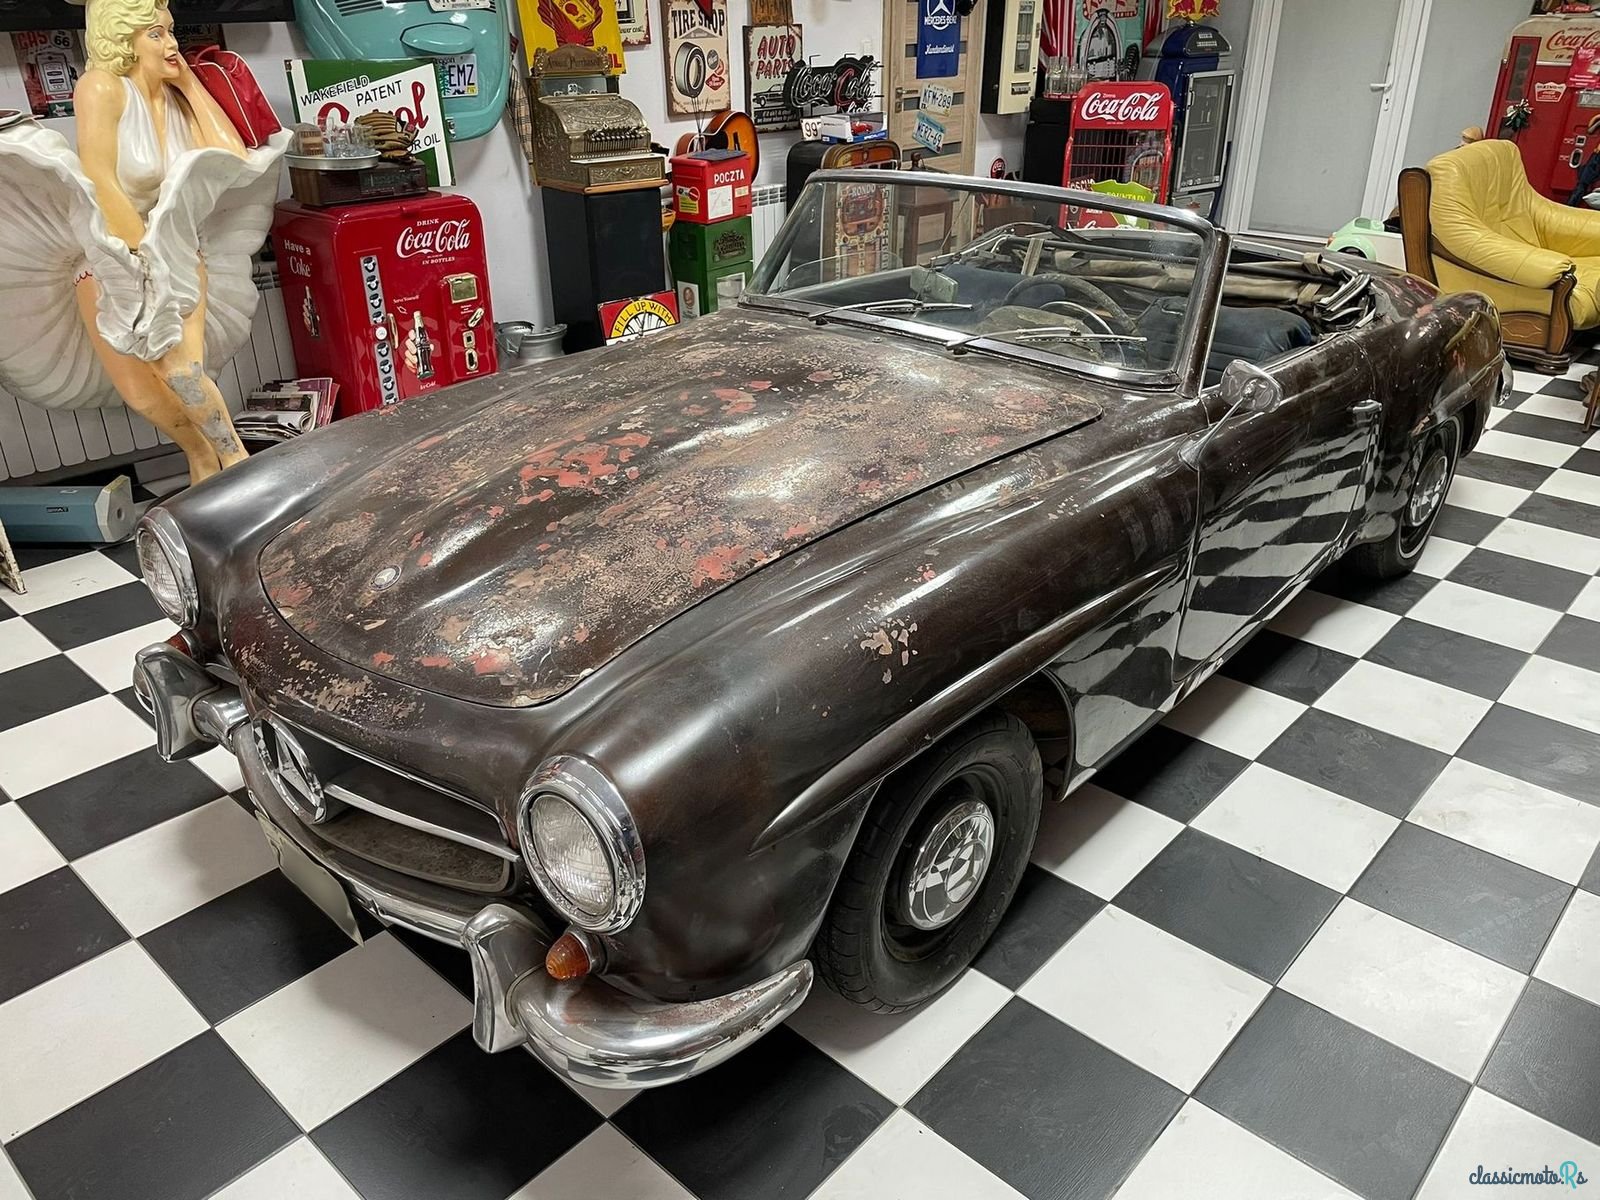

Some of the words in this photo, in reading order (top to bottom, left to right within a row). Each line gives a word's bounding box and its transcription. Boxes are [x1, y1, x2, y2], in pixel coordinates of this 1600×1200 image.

[671, 10, 696, 39] TIRE
[54, 35, 70, 47] 66
[757, 35, 796, 60] AUTO
[756, 59, 795, 80] PARTS
[301, 76, 369, 107] WAKEFIELD
[356, 80, 402, 107] PATENT
[1081, 92, 1165, 121] Coca-Cola
[424, 133, 440, 147] OIL
[714, 168, 745, 185] POCZTA
[417, 218, 440, 227] DRINK
[284, 240, 304, 253] Have
[305, 247, 311, 255] a
[396, 219, 471, 258] Coca-Cola
[430, 256, 455, 264] BOTTLES
[615, 309, 633, 333] FILL
[634, 301, 646, 312] UP
[648, 302, 672, 323] WITH
